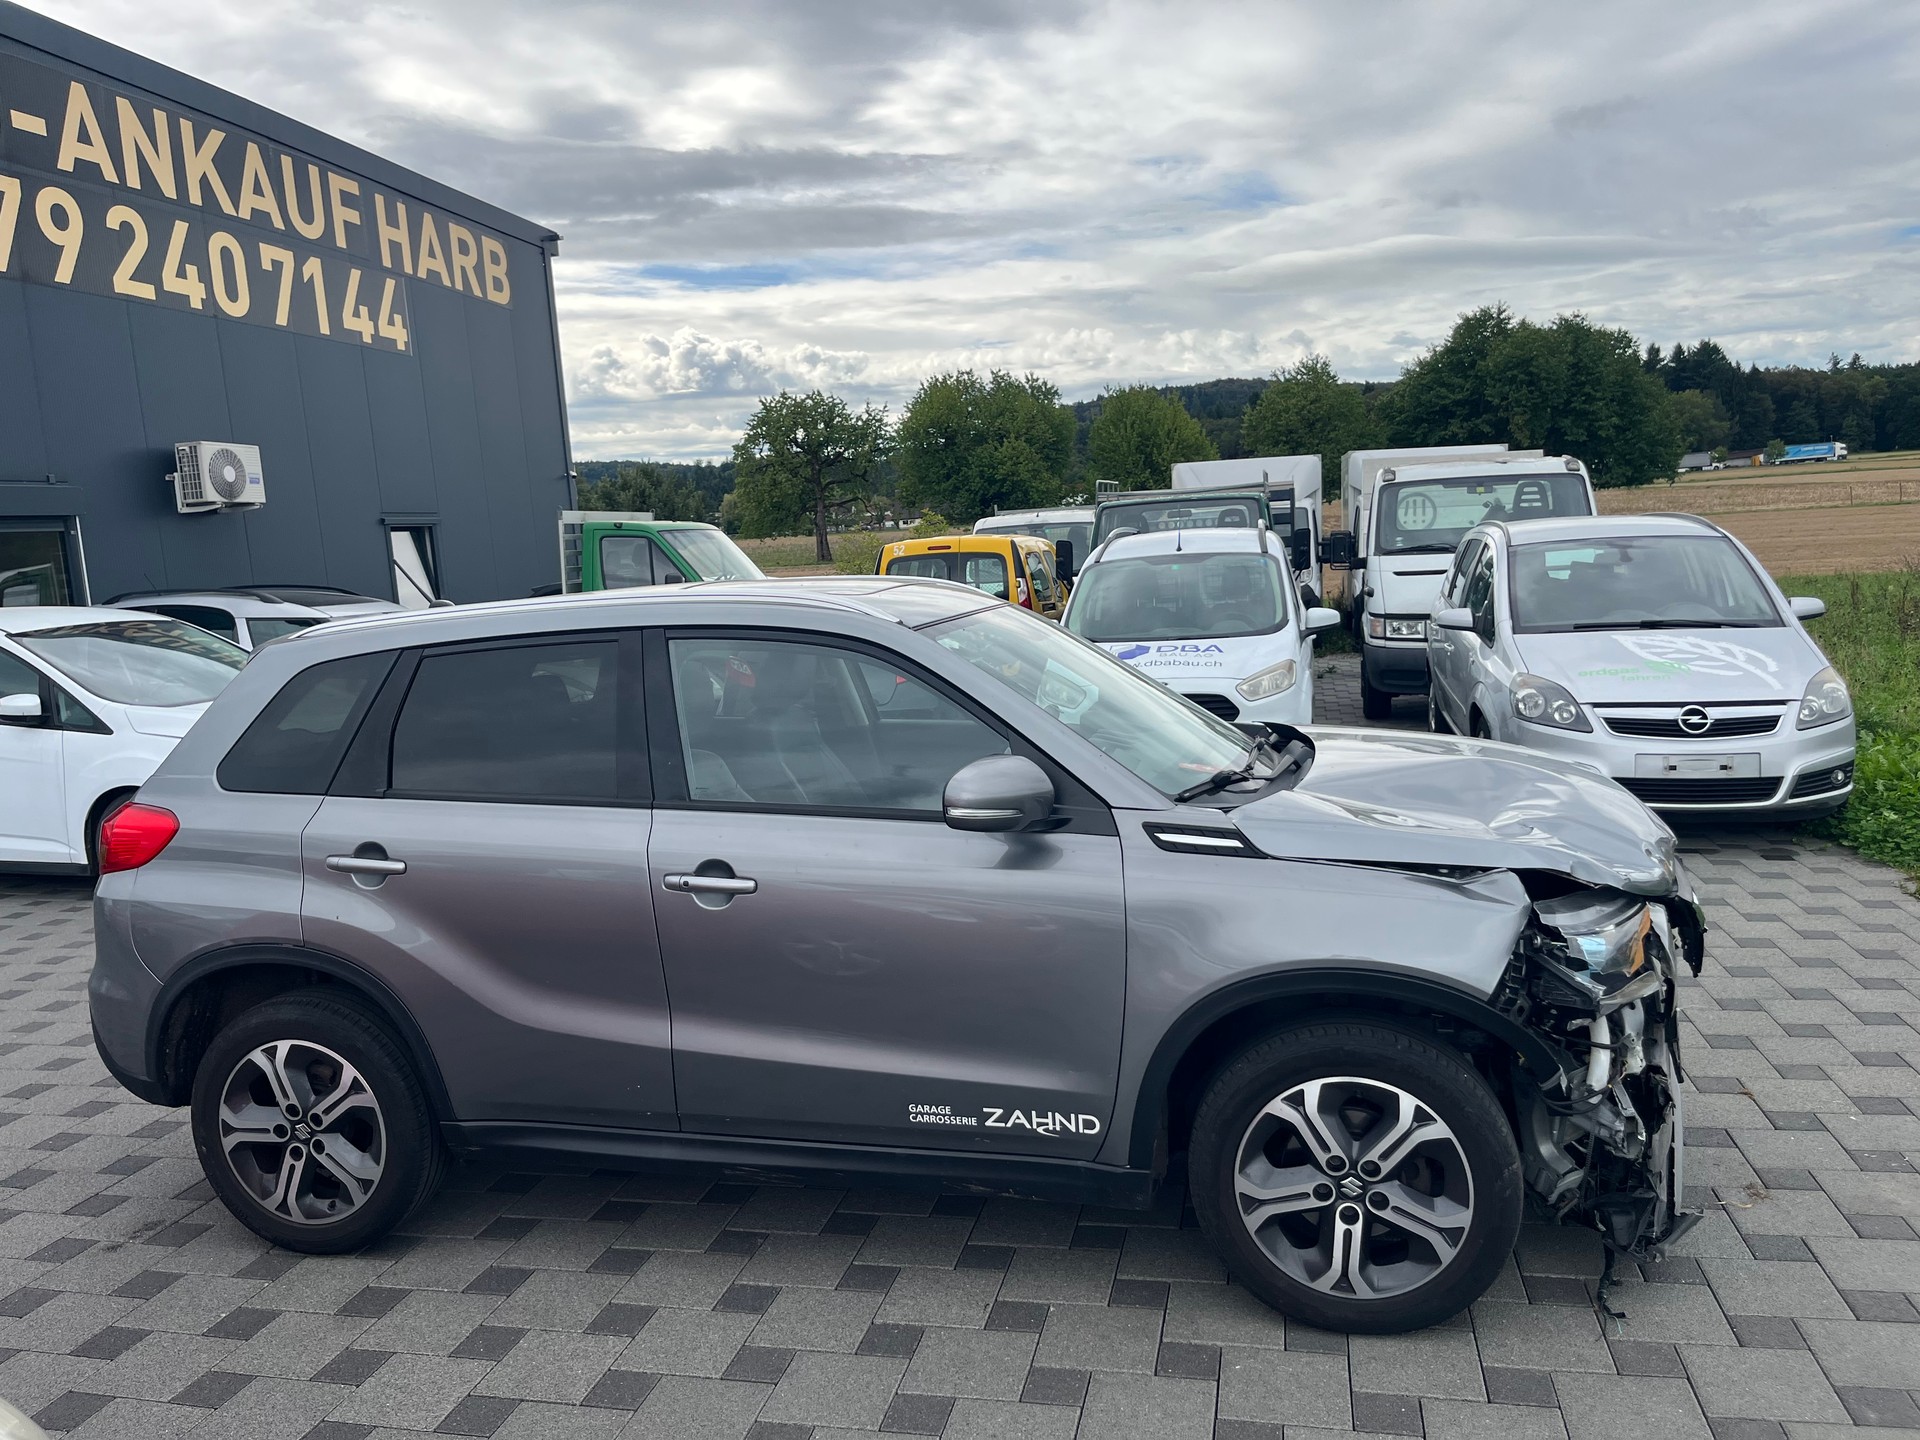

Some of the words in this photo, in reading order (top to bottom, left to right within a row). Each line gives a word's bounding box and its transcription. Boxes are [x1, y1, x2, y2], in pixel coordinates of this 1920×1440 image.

[374, 192, 511, 305] HARB
[893, 544, 905, 556] 52
[1156, 644, 1224, 653] DBA
[908, 1103, 952, 1114] GARAGE
[909, 1113, 978, 1126] CARROSSERIE
[983, 1107, 1101, 1136] ZAHND
